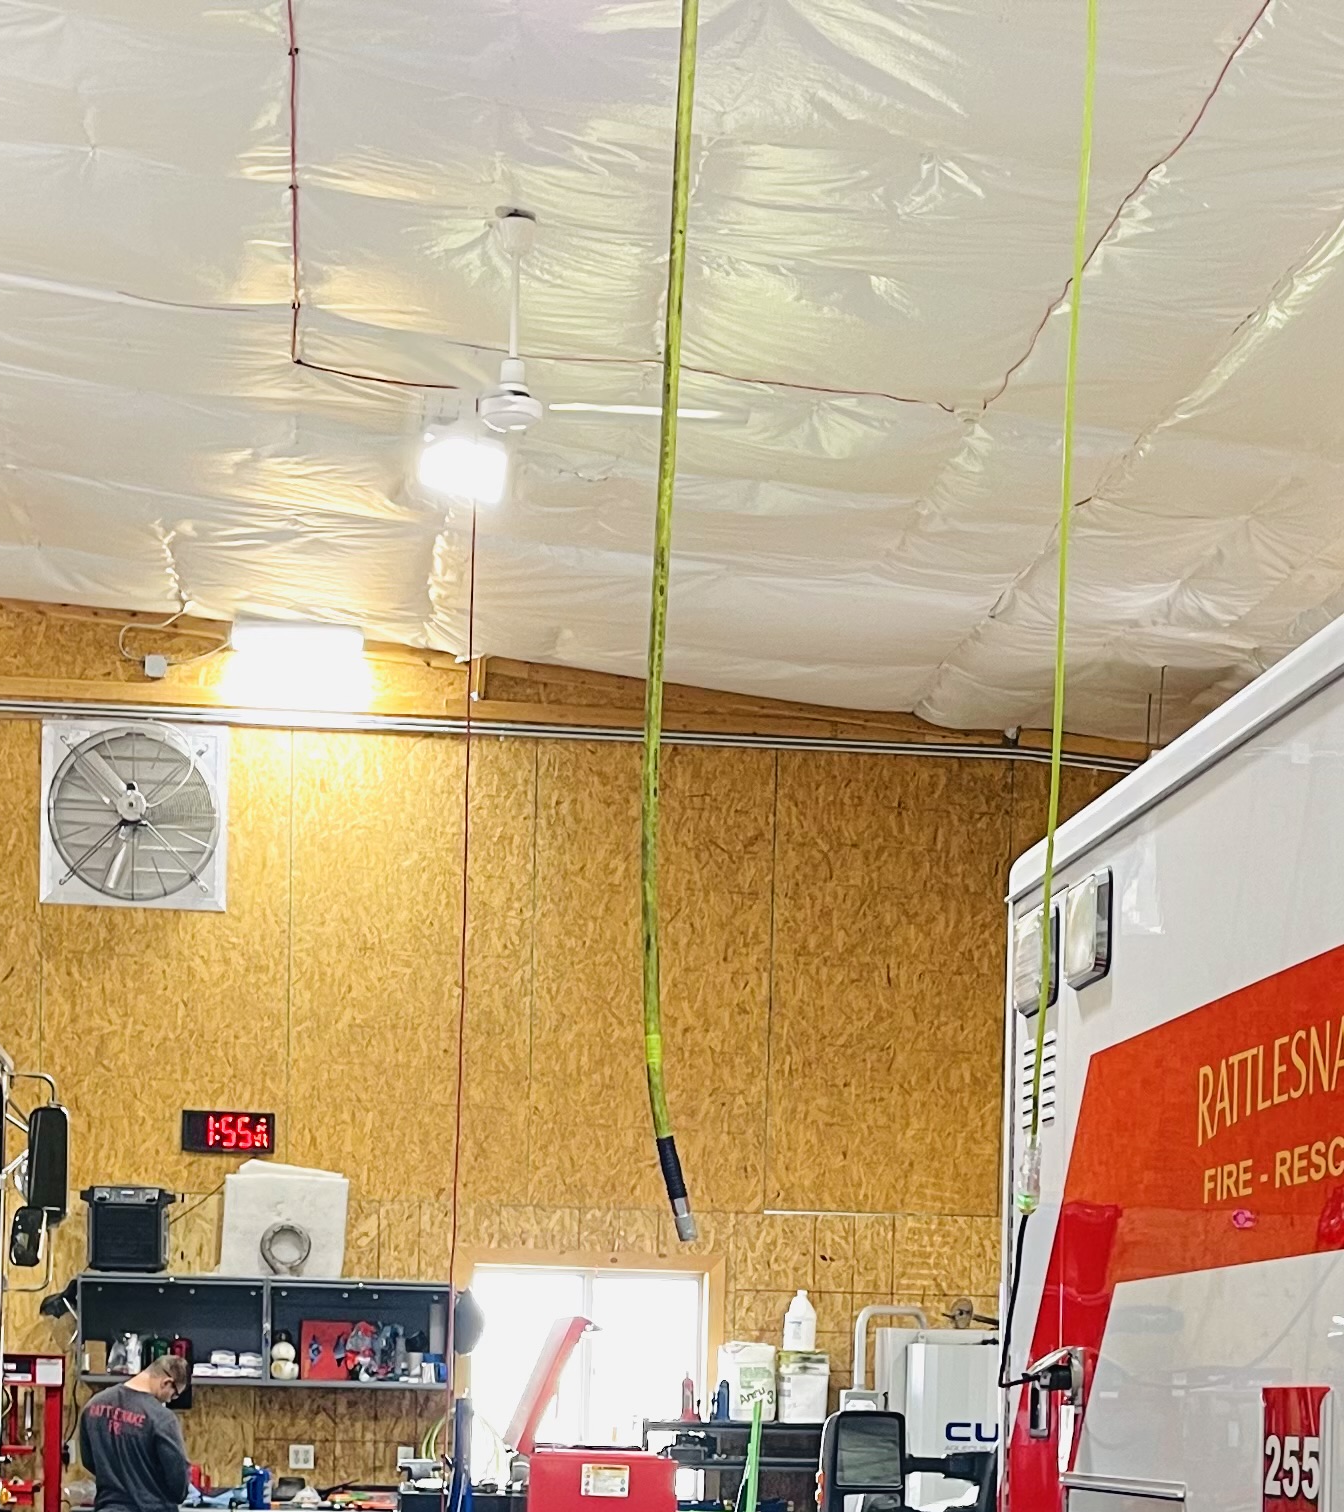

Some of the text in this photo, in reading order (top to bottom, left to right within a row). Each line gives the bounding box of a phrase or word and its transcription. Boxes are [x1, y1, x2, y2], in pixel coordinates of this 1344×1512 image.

[208, 1115, 253, 1148] 1:55
[1203, 1158, 1254, 1205] FIRE
[1264, 1434, 1320, 1501] 255
